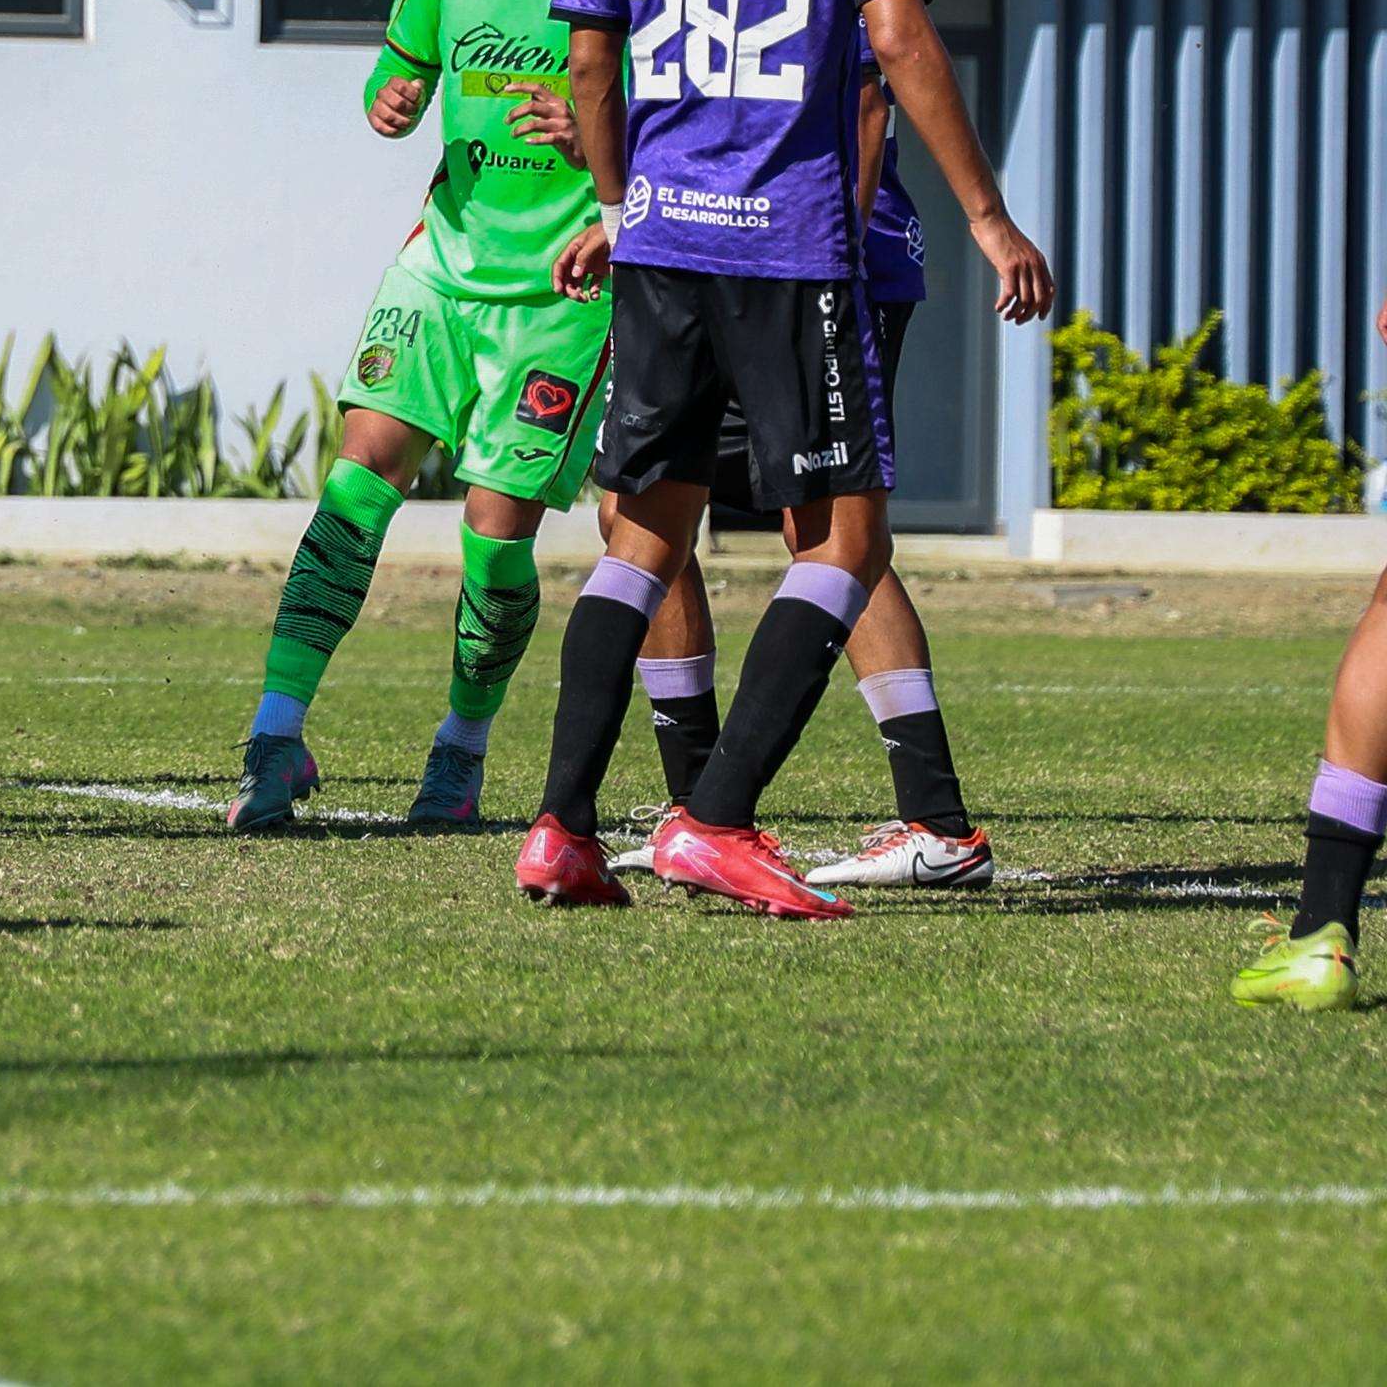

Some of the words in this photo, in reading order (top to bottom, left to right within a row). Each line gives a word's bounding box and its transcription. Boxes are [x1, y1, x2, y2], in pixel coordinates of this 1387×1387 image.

[486, 151, 556, 171] Juarez
[657, 188, 678, 202] EL
[681, 191, 771, 212] ENCANTO
[661, 206, 770, 228] DESARROLLOS
[366, 307, 424, 348] 234
[828, 391, 846, 422] STI
[793, 441, 849, 475] Nazil
